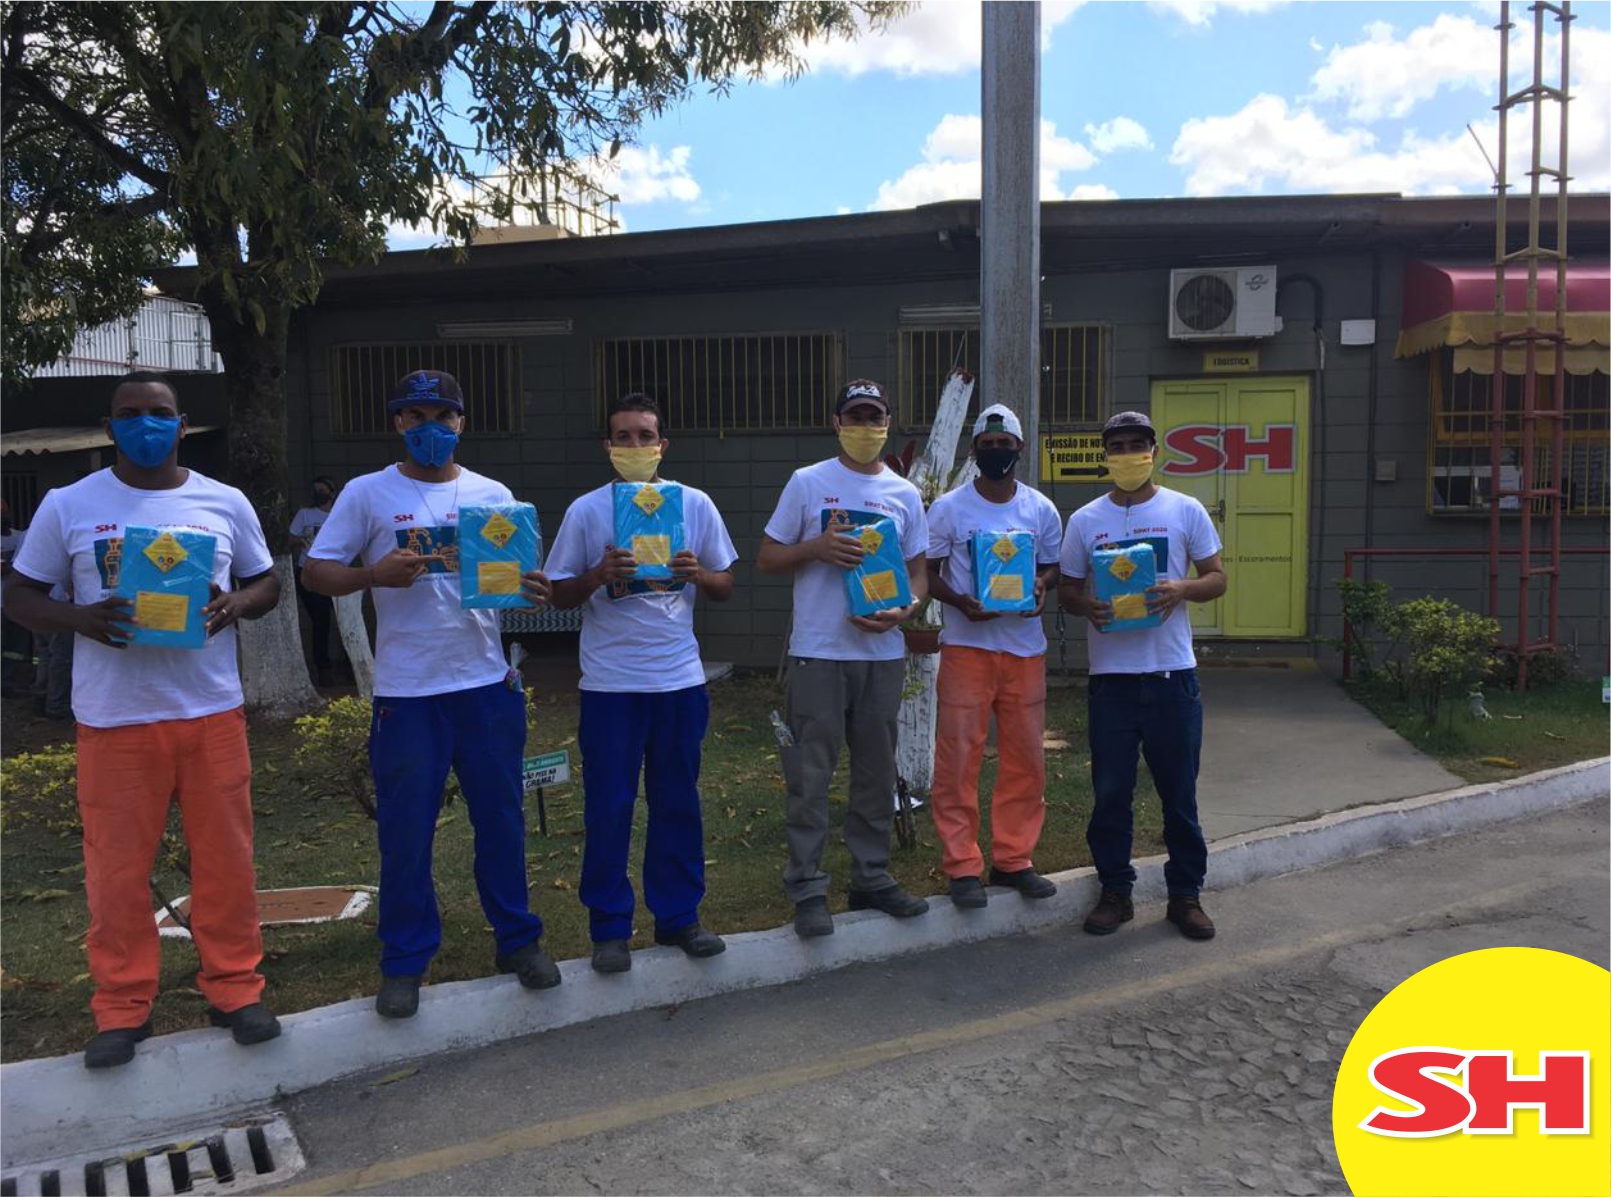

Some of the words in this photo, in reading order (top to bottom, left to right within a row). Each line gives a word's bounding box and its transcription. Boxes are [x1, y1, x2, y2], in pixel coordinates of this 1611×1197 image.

[1045, 436, 1078, 449] EMISSÃO
[1079, 438, 1089, 449] DE
[1089, 438, 1105, 449] NOT
[1160, 424, 1297, 476] SH
[1056, 452, 1084, 463] RECIBO
[1084, 452, 1095, 463] DE
[393, 513, 414, 523] SH
[94, 523, 117, 534] SH
